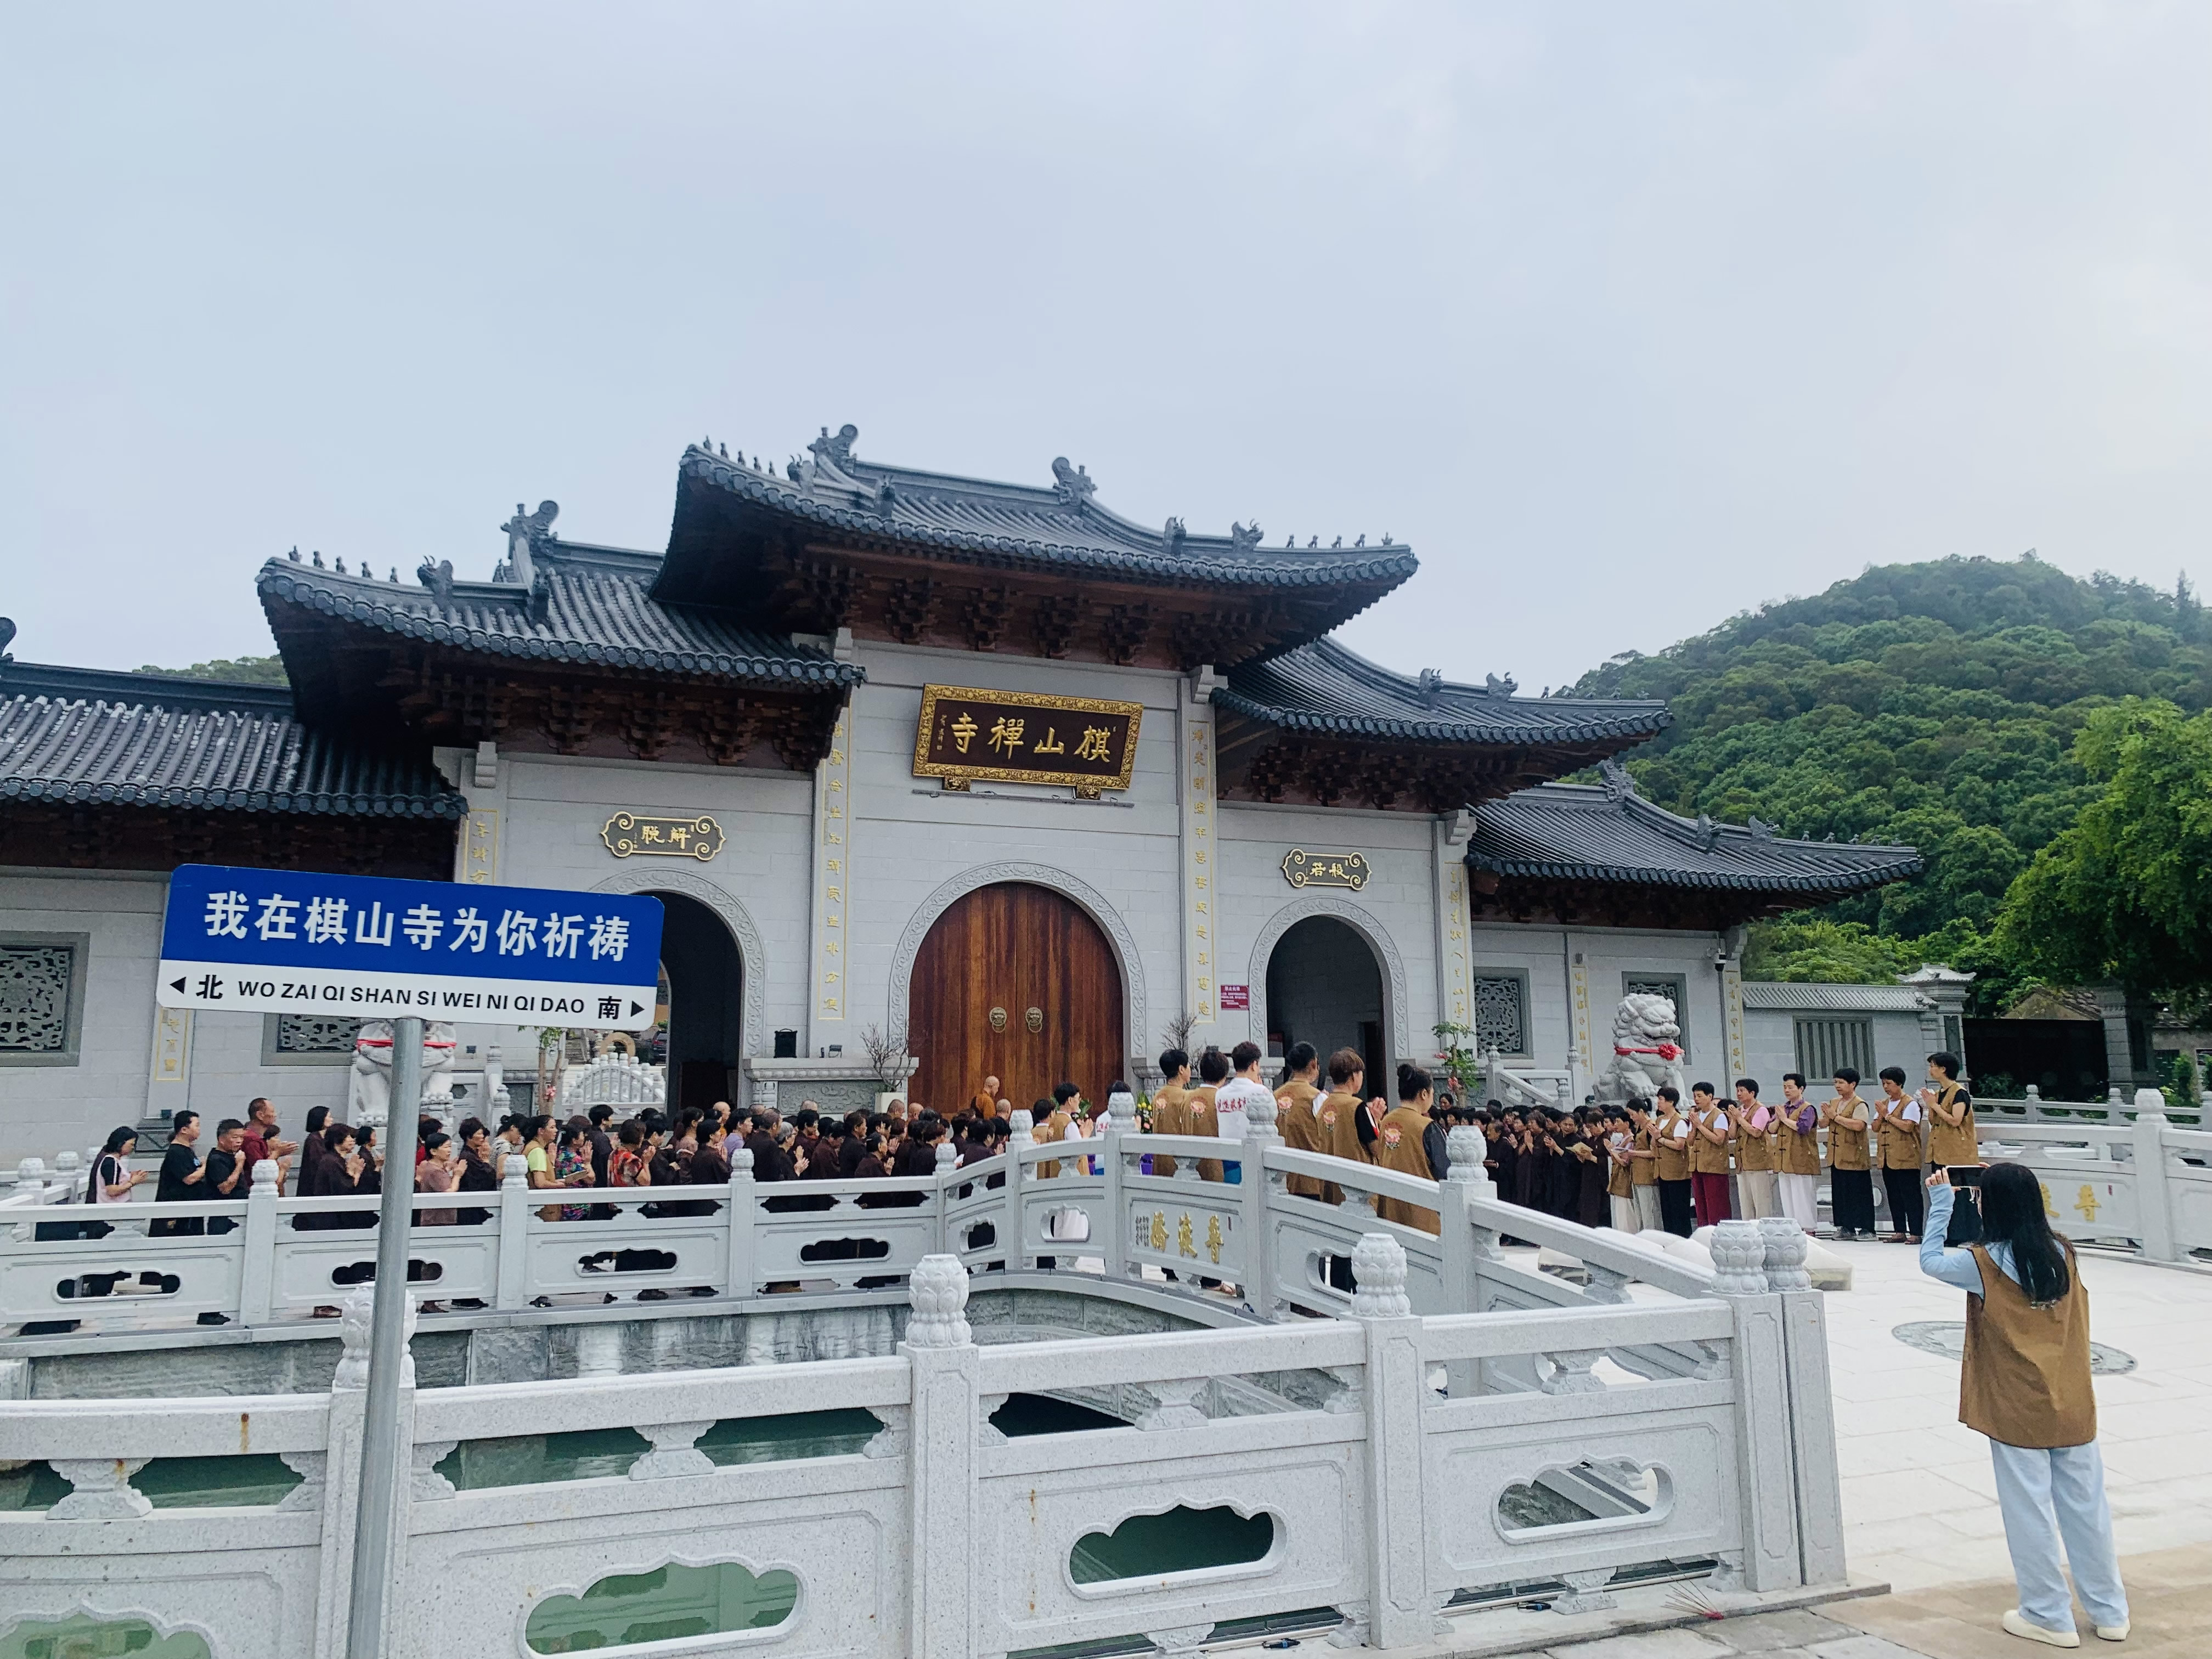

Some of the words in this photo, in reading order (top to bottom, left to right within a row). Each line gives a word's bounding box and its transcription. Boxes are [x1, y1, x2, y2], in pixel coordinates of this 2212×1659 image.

[205, 890, 630, 962] 我在棋山寺为你祈祷
[196, 974, 223, 1000] 北
[238, 981, 275, 997] WO
[281, 983, 317, 1000] ZAI
[323, 986, 345, 1001] QI
[351, 987, 411, 1004] SHAN
[417, 991, 436, 1006] SI
[443, 992, 481, 1008] WEI
[487, 994, 508, 1009] NI
[514, 996, 535, 1011] QI
[541, 997, 584, 1013] DAO
[598, 996, 622, 1020] 南
